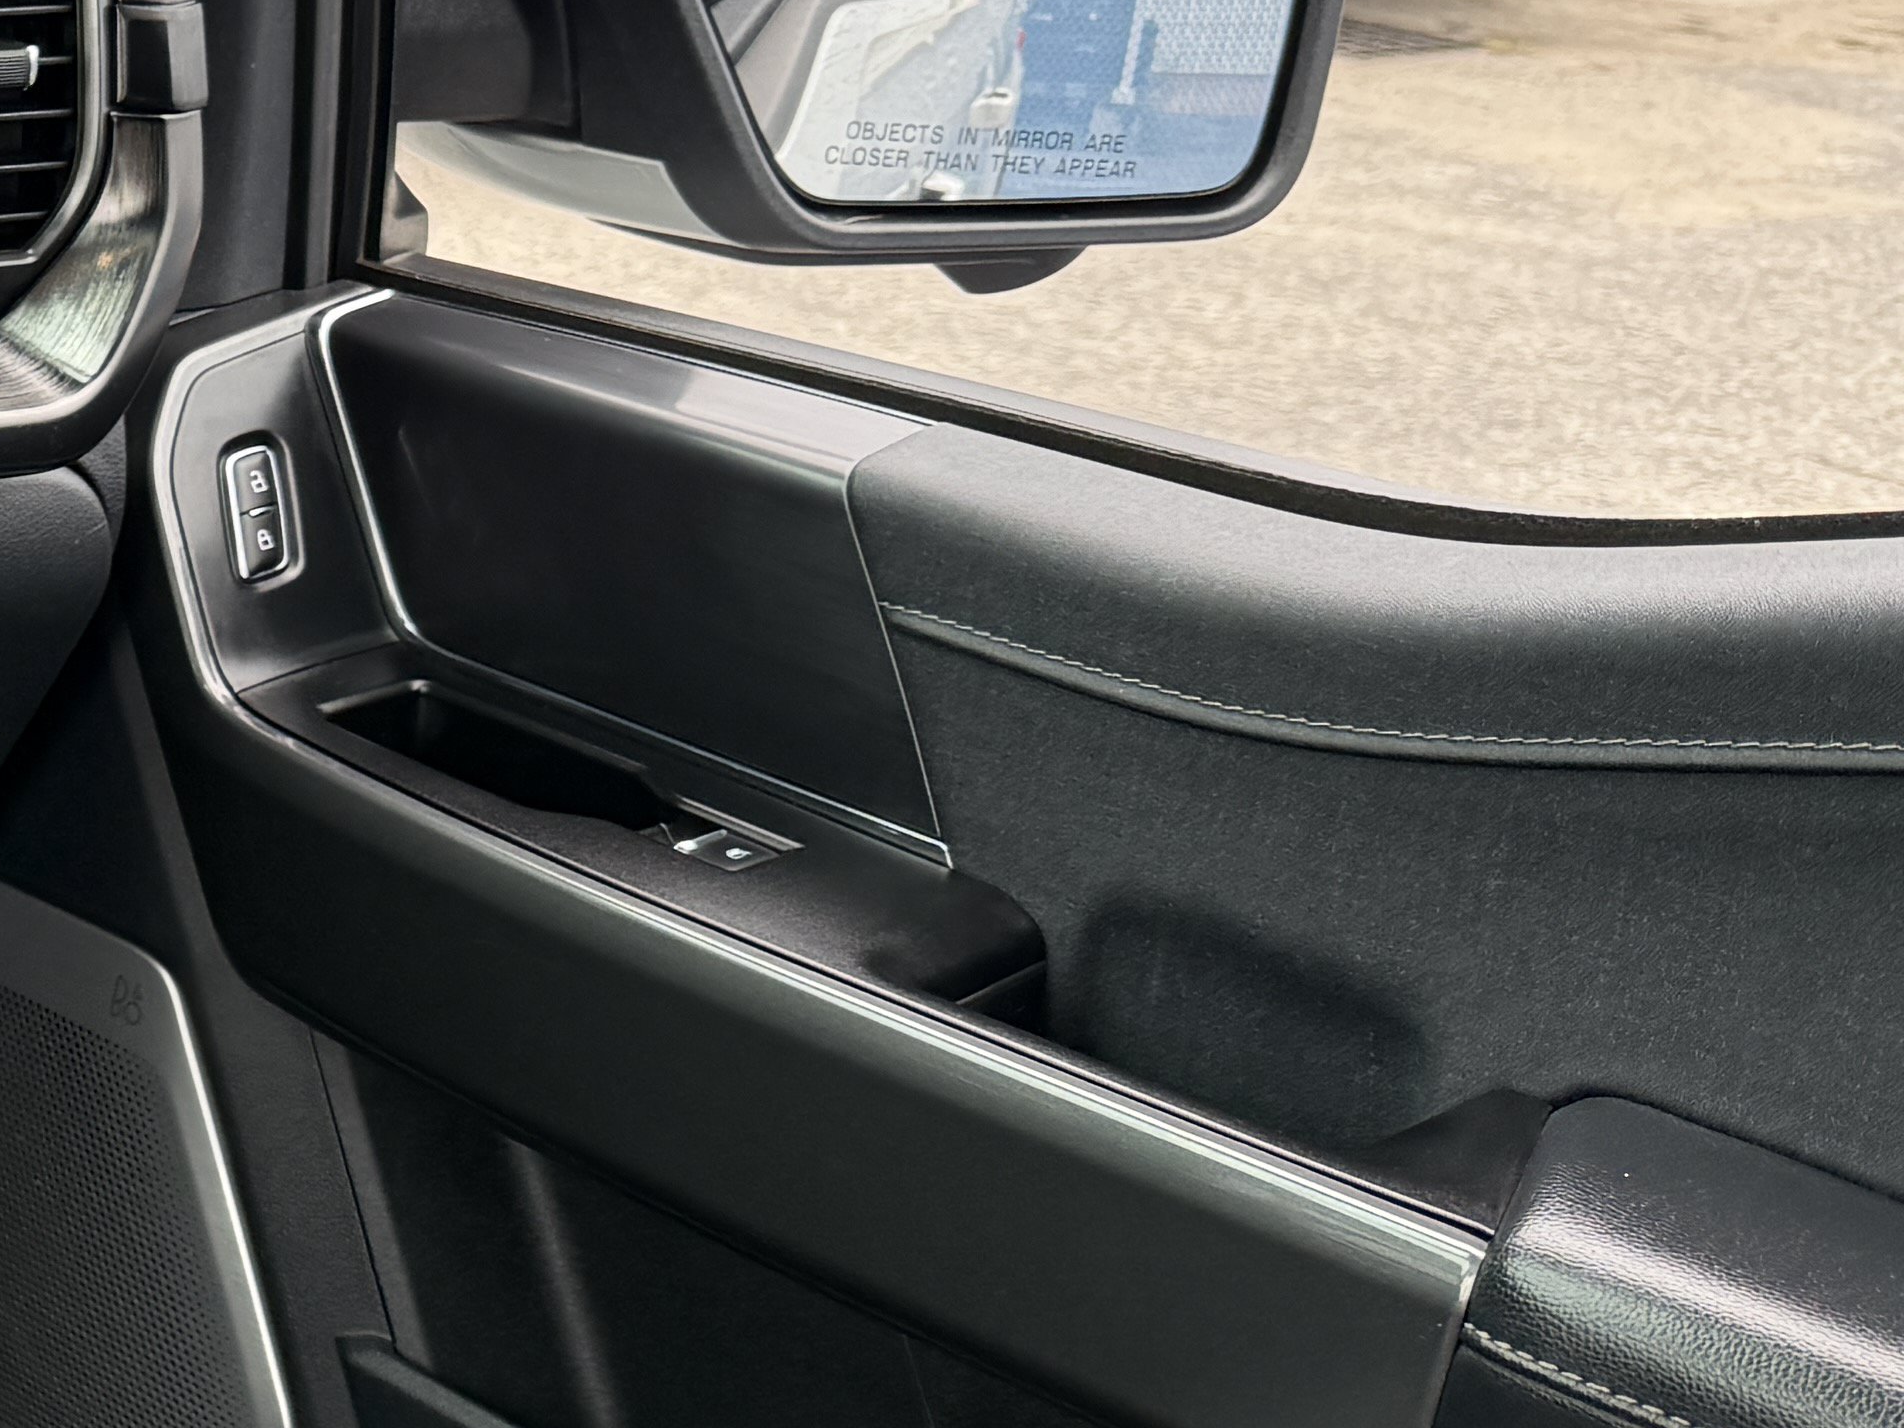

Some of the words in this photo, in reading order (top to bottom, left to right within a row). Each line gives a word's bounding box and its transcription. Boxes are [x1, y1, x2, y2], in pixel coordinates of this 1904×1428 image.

[845, 120, 944, 145] OBJECTS
[957, 125, 978, 146] IN
[991, 127, 1073, 152] MIRROR
[1083, 133, 1128, 154] ARE
[824, 145, 909, 168] CLOSER
[923, 150, 980, 172] THAN
[992, 154, 1046, 176] THEY
[1055, 158, 1138, 179] APPEAR
